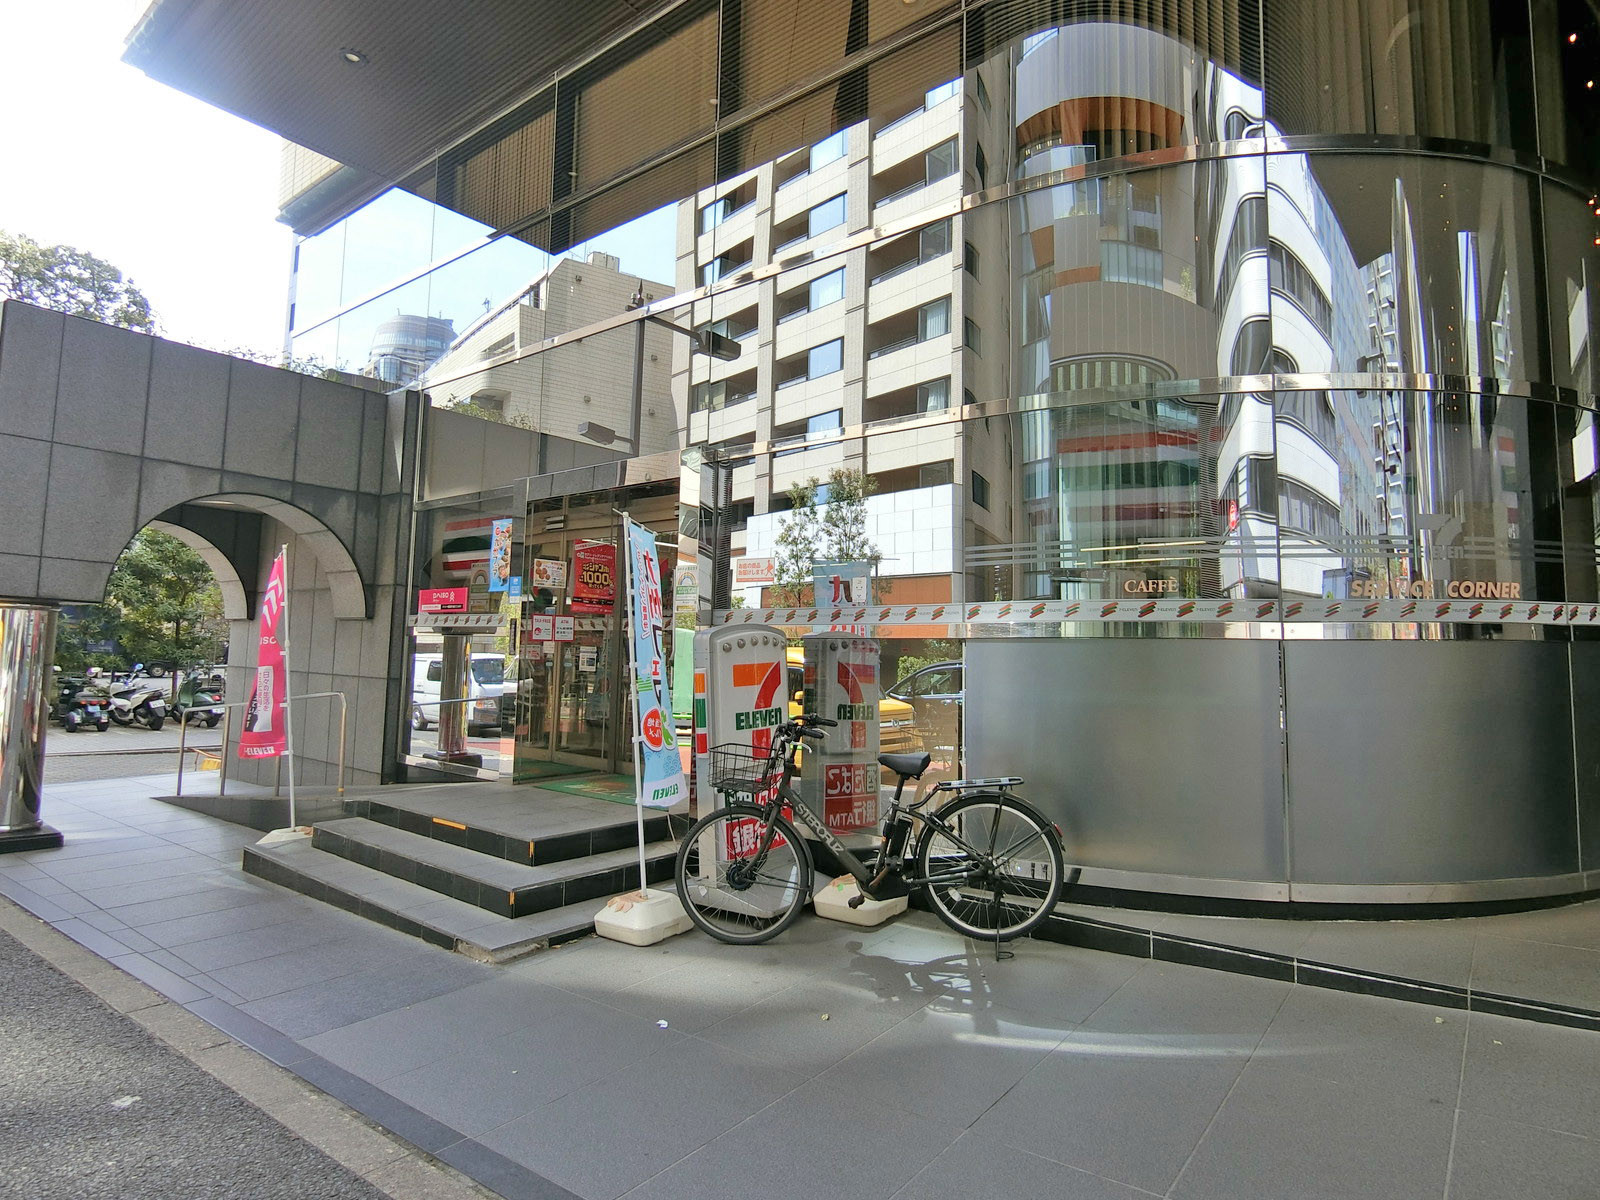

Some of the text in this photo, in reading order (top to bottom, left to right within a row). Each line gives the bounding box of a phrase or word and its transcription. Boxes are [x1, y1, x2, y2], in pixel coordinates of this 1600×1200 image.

[1124, 576, 1179, 593] CAFFÈ
[1350, 580, 1521, 599] SERVICE CORNER
[732, 660, 782, 760] 7
